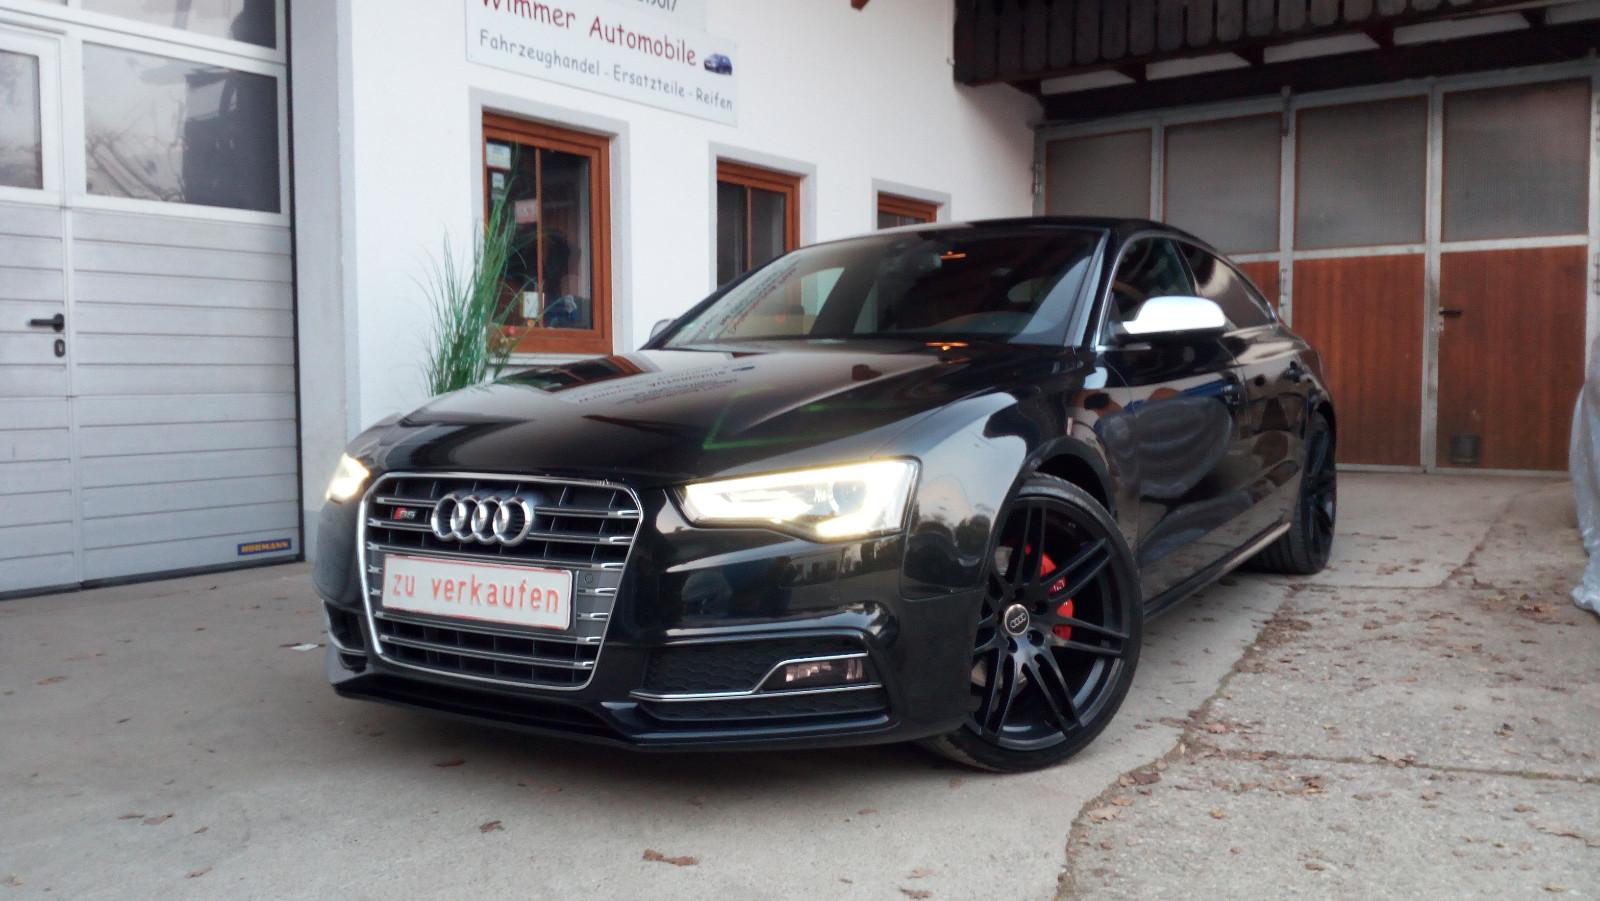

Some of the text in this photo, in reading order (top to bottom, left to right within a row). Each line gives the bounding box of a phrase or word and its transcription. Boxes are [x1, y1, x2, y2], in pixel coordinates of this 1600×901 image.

[589, 16, 697, 67] Automobile
[480, 28, 600, 77] Fahrzeughandel
[613, 64, 685, 98] Ersatzteile
[696, 87, 733, 112] Reifen
[393, 572, 560, 614] zu verkaufen
